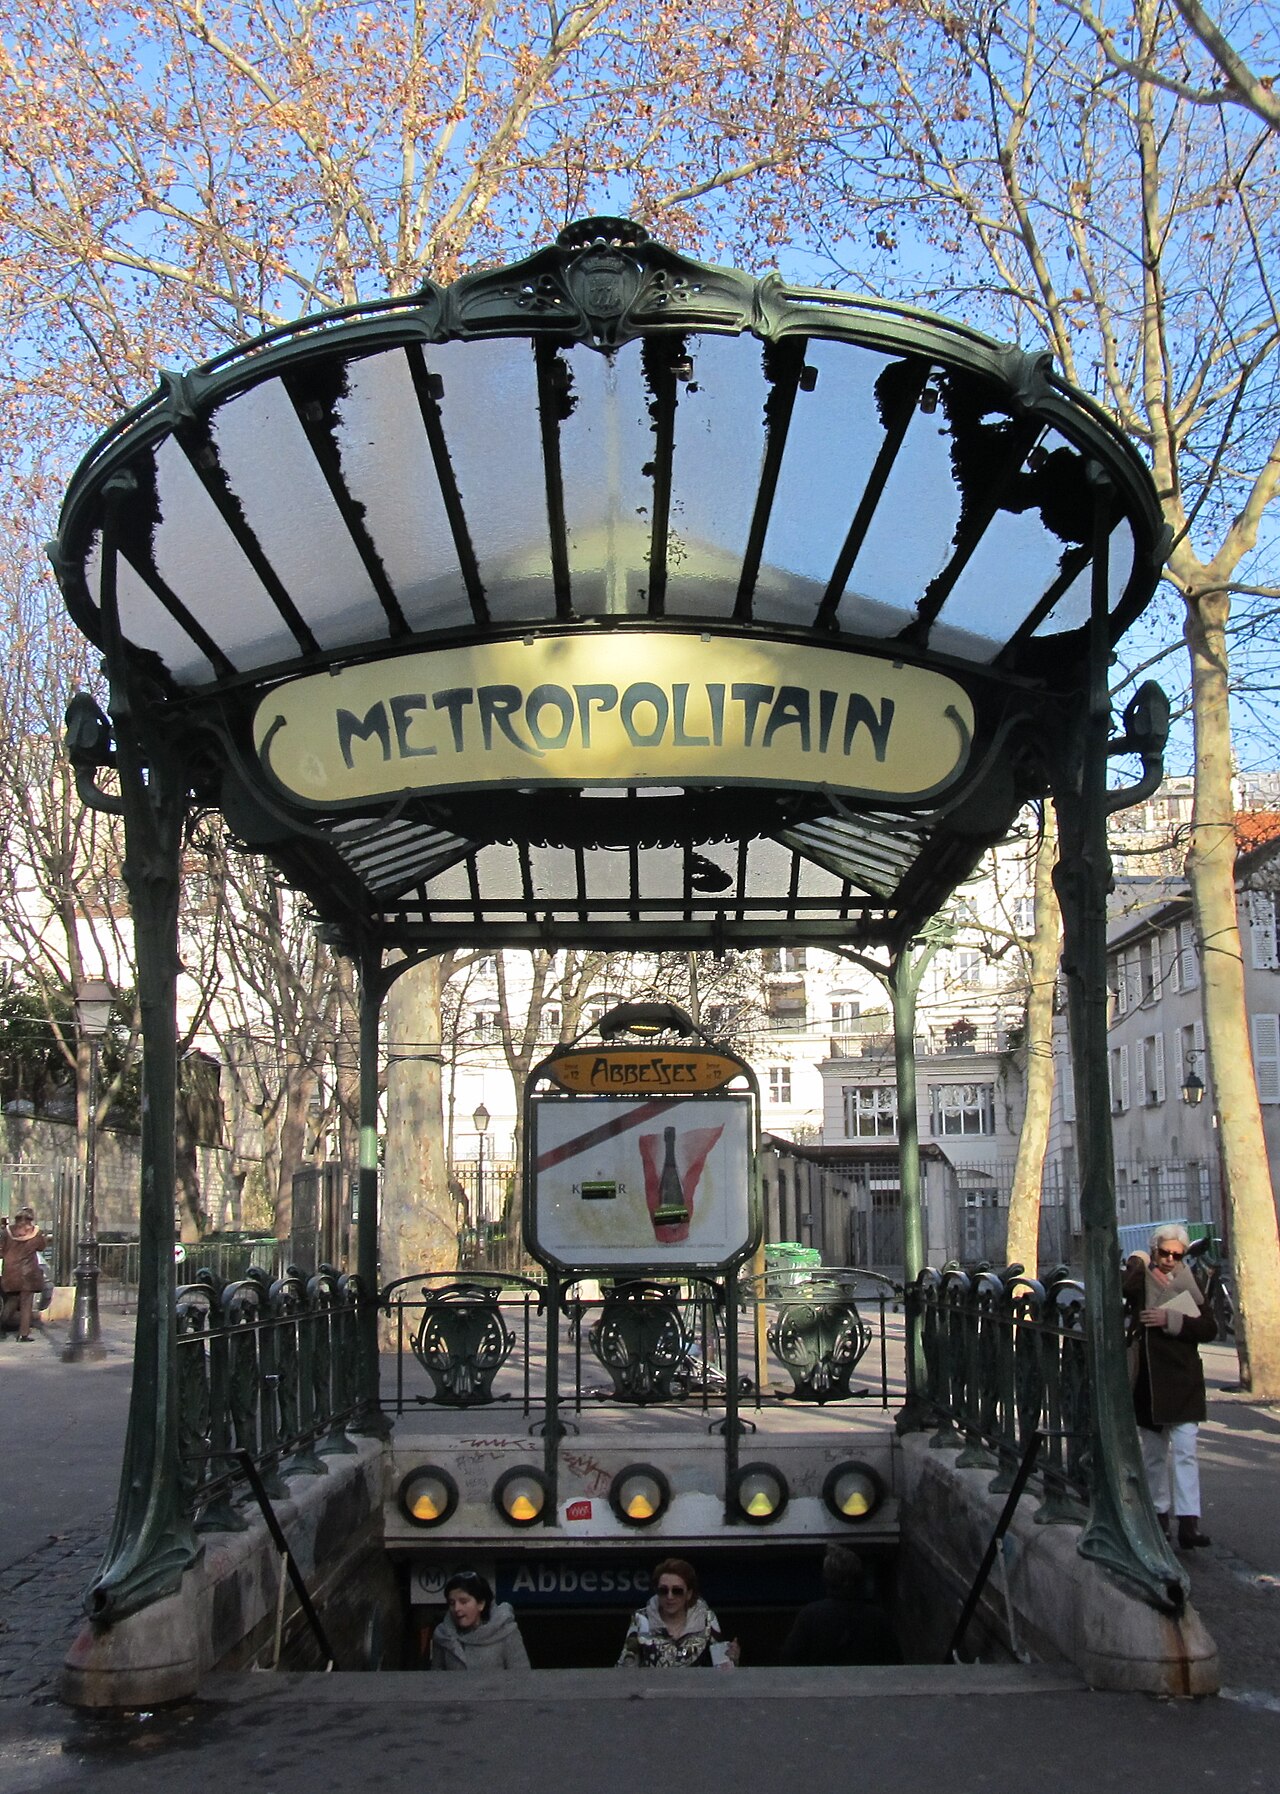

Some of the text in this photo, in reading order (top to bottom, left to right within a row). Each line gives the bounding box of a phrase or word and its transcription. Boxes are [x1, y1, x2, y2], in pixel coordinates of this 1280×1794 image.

[336, 682, 895, 769] METROPOLITAIN
[590, 1057, 698, 1087] ABBESSES
[425, 1571, 441, 1587] M
[512, 1563, 650, 1593] Abbesse
